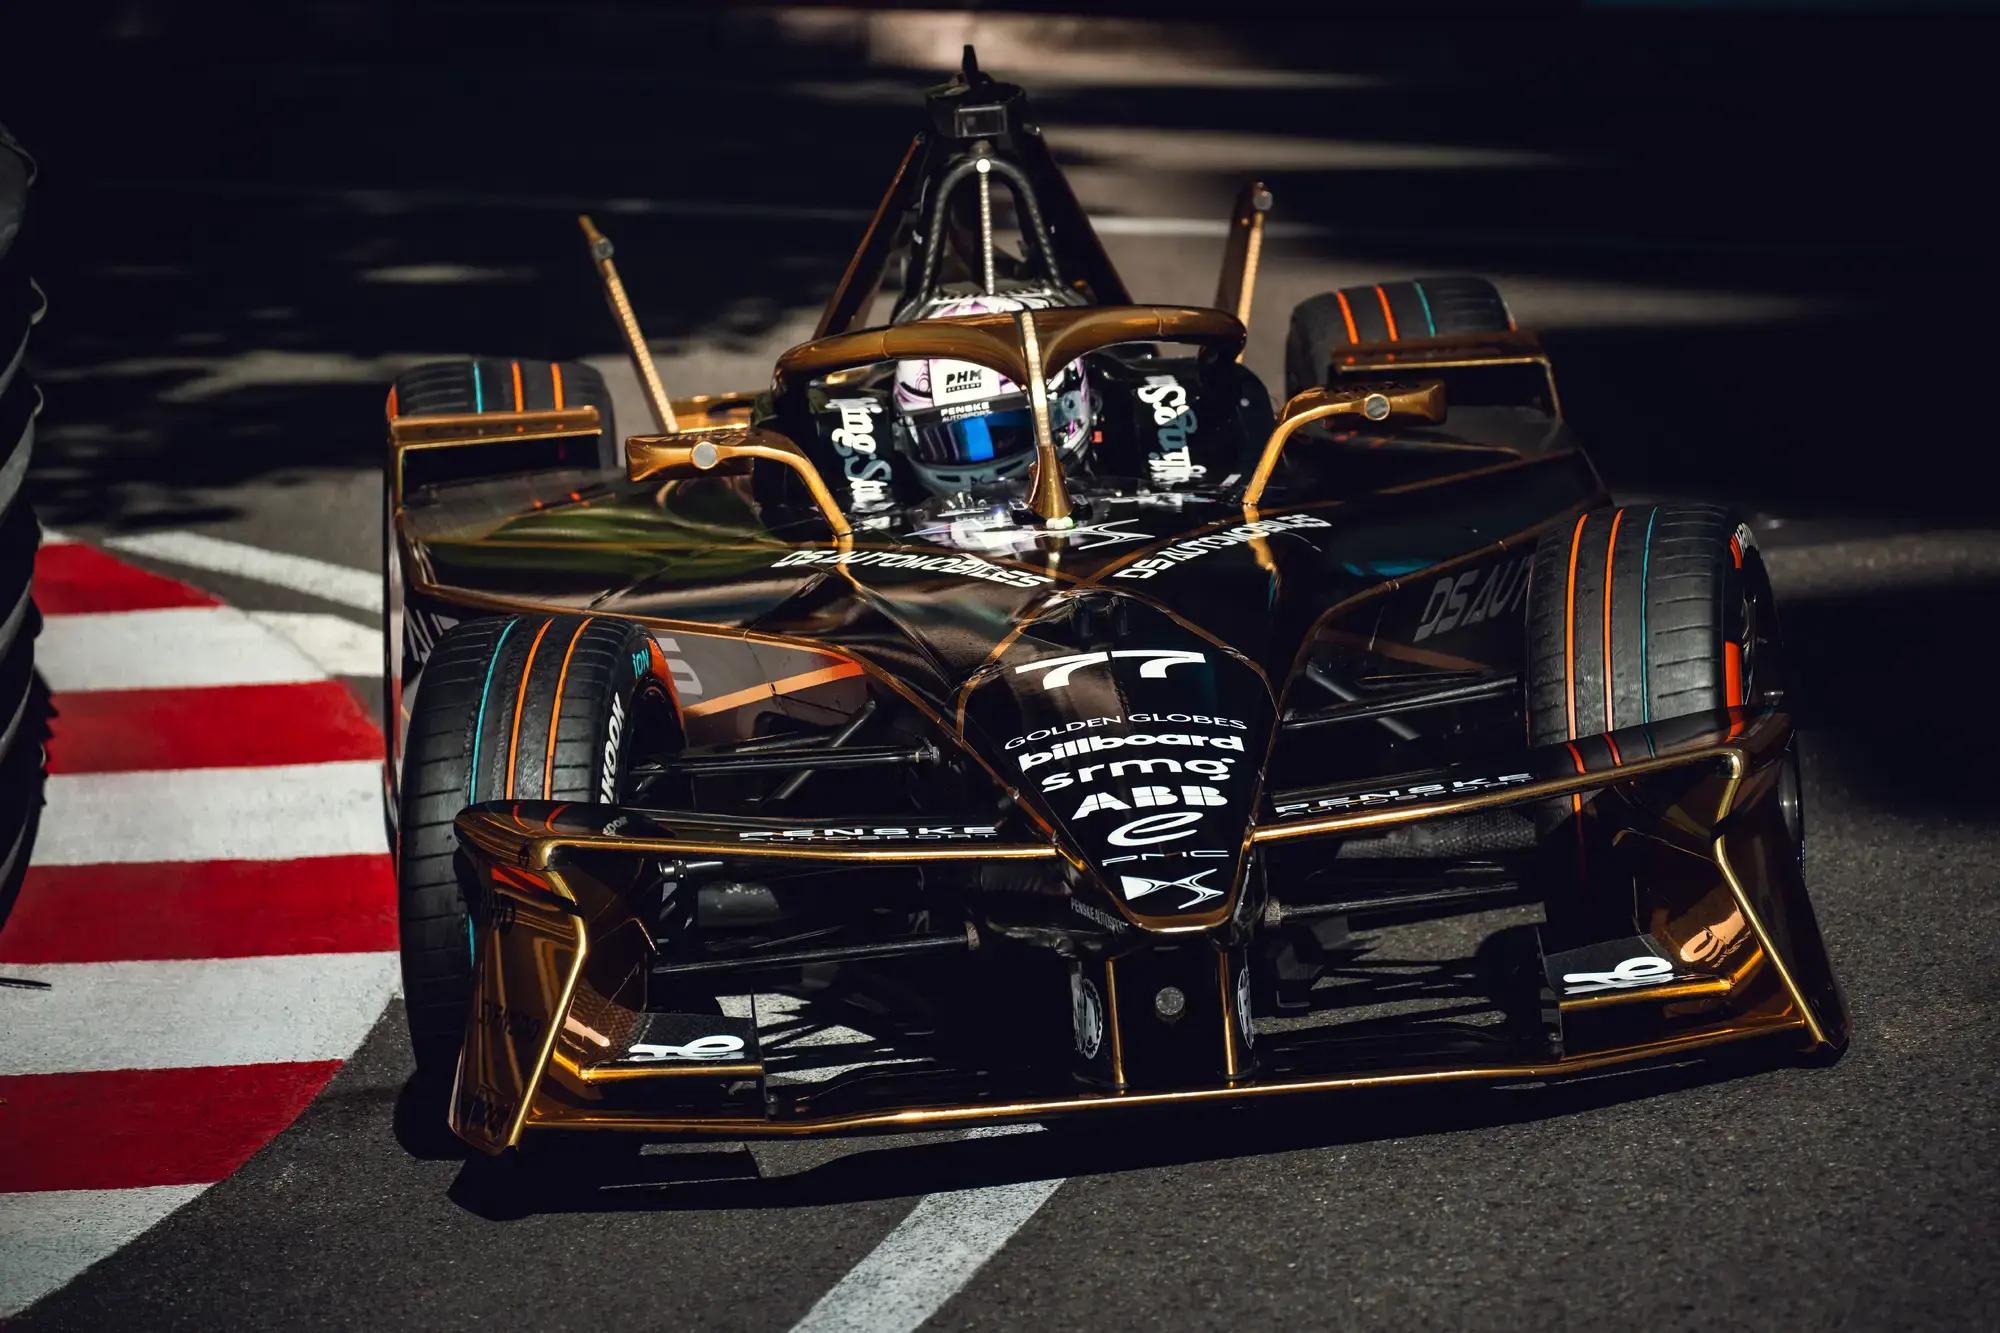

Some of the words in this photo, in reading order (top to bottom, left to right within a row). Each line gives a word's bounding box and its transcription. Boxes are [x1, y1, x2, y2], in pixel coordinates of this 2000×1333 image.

[946, 368, 982, 386] PHM
[940, 401, 990, 417] PENSKE
[941, 410, 992, 423] AUTOSPORT
[1014, 649, 1207, 690] 77
[1004, 715, 1122, 751] GOLDEN
[1128, 713, 1248, 730] GLOBES
[1018, 733, 1245, 773] billboard
[1041, 757, 1236, 793] srmg
[1071, 785, 1228, 820] ABB
[1275, 773, 1533, 813] PENSKE
[739, 826, 997, 838] PENSKE
[1070, 896, 1095, 921] PENSKE
